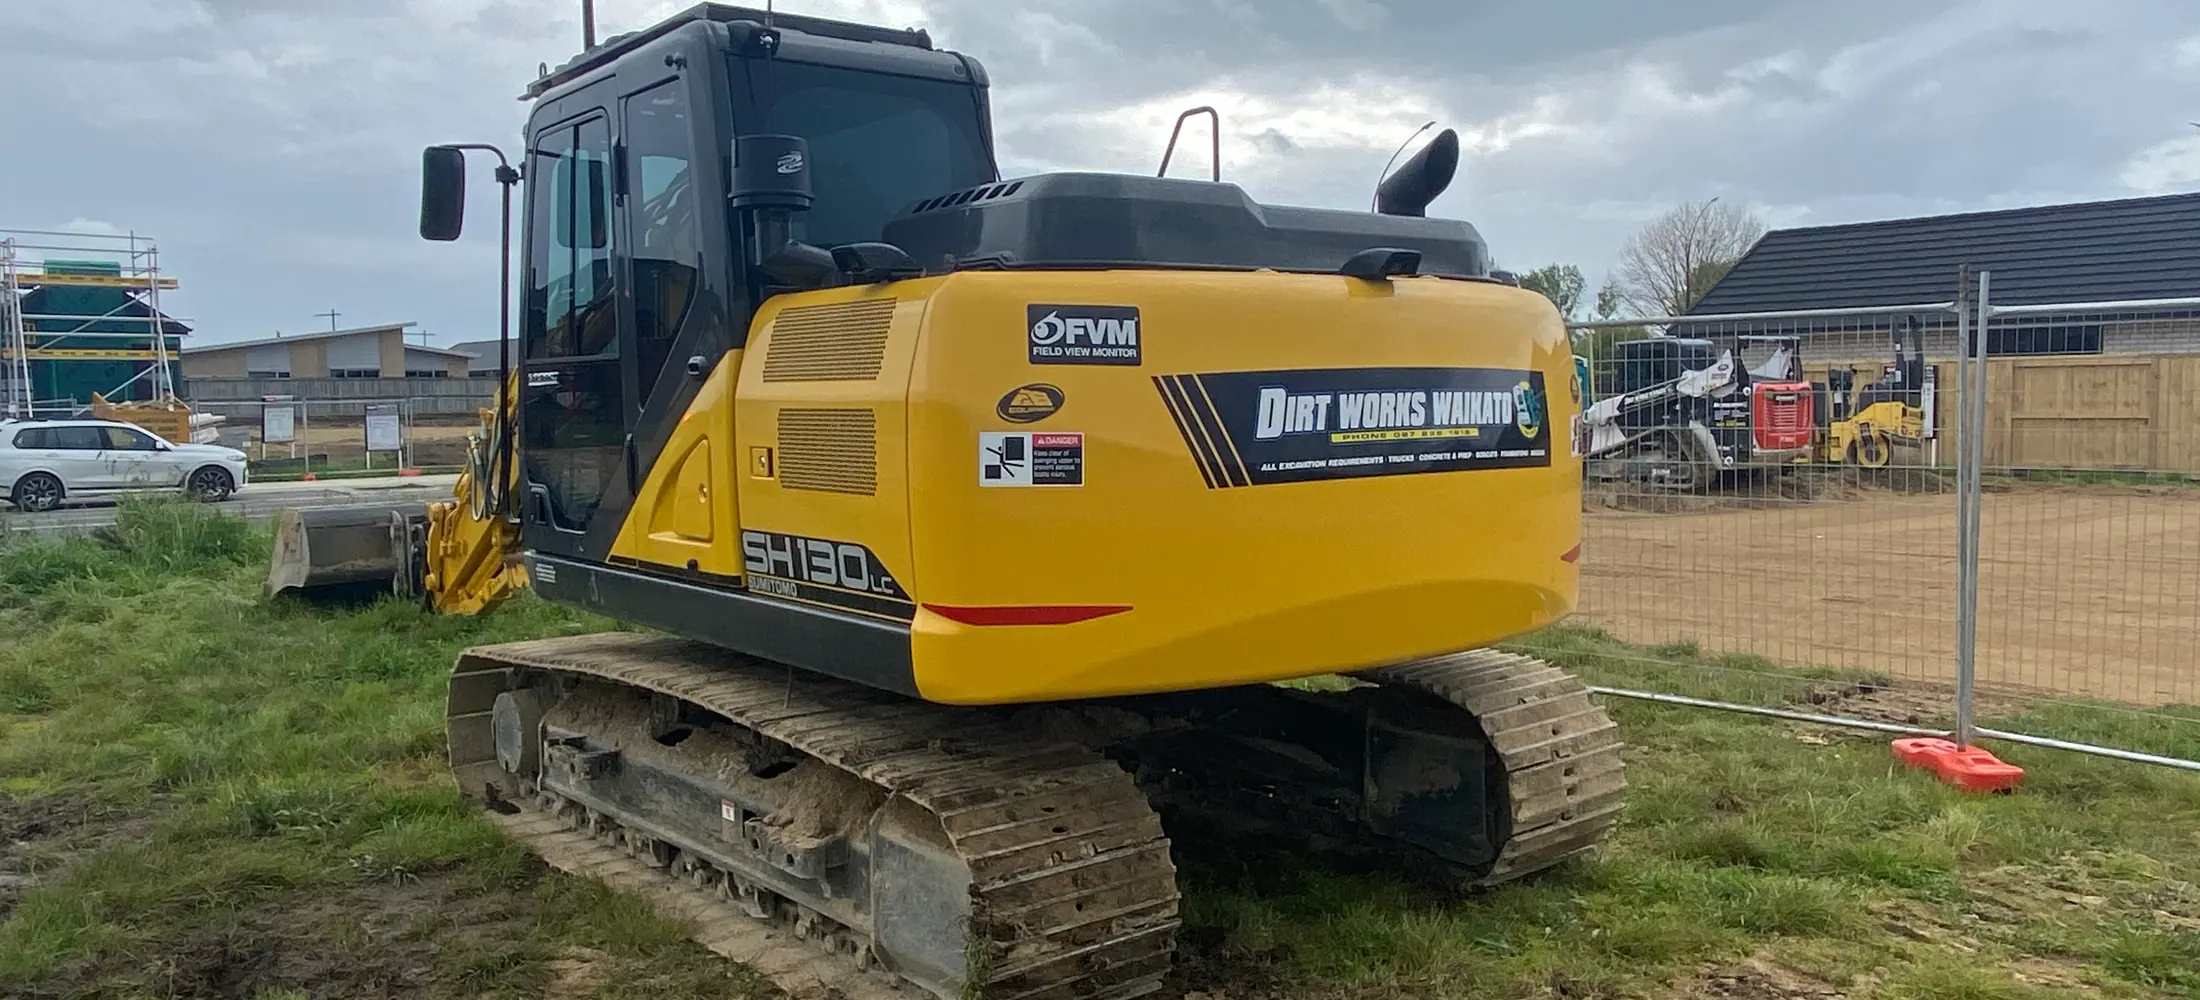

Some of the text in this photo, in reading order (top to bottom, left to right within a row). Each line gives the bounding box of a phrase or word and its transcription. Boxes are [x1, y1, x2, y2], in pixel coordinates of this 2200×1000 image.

[1065, 318, 1137, 345] FVM
[1033, 346, 1137, 358] FIELD VIEW MONITOR
[1256, 388, 1512, 439] DIRT WORKS WAIKATO
[1045, 436, 1079, 445] DANGER
[1342, 431, 1387, 441] PHONE
[1261, 463, 1277, 472] ALL
[1279, 460, 1327, 471] EXCAVATION
[1328, 456, 1384, 467] REQUIREMENTS
[1388, 454, 1415, 463] TRUCKS
[1419, 452, 1451, 461] CONCRETE
[742, 531, 894, 595] SH130 LC
[748, 575, 798, 597] SUMITOMO
